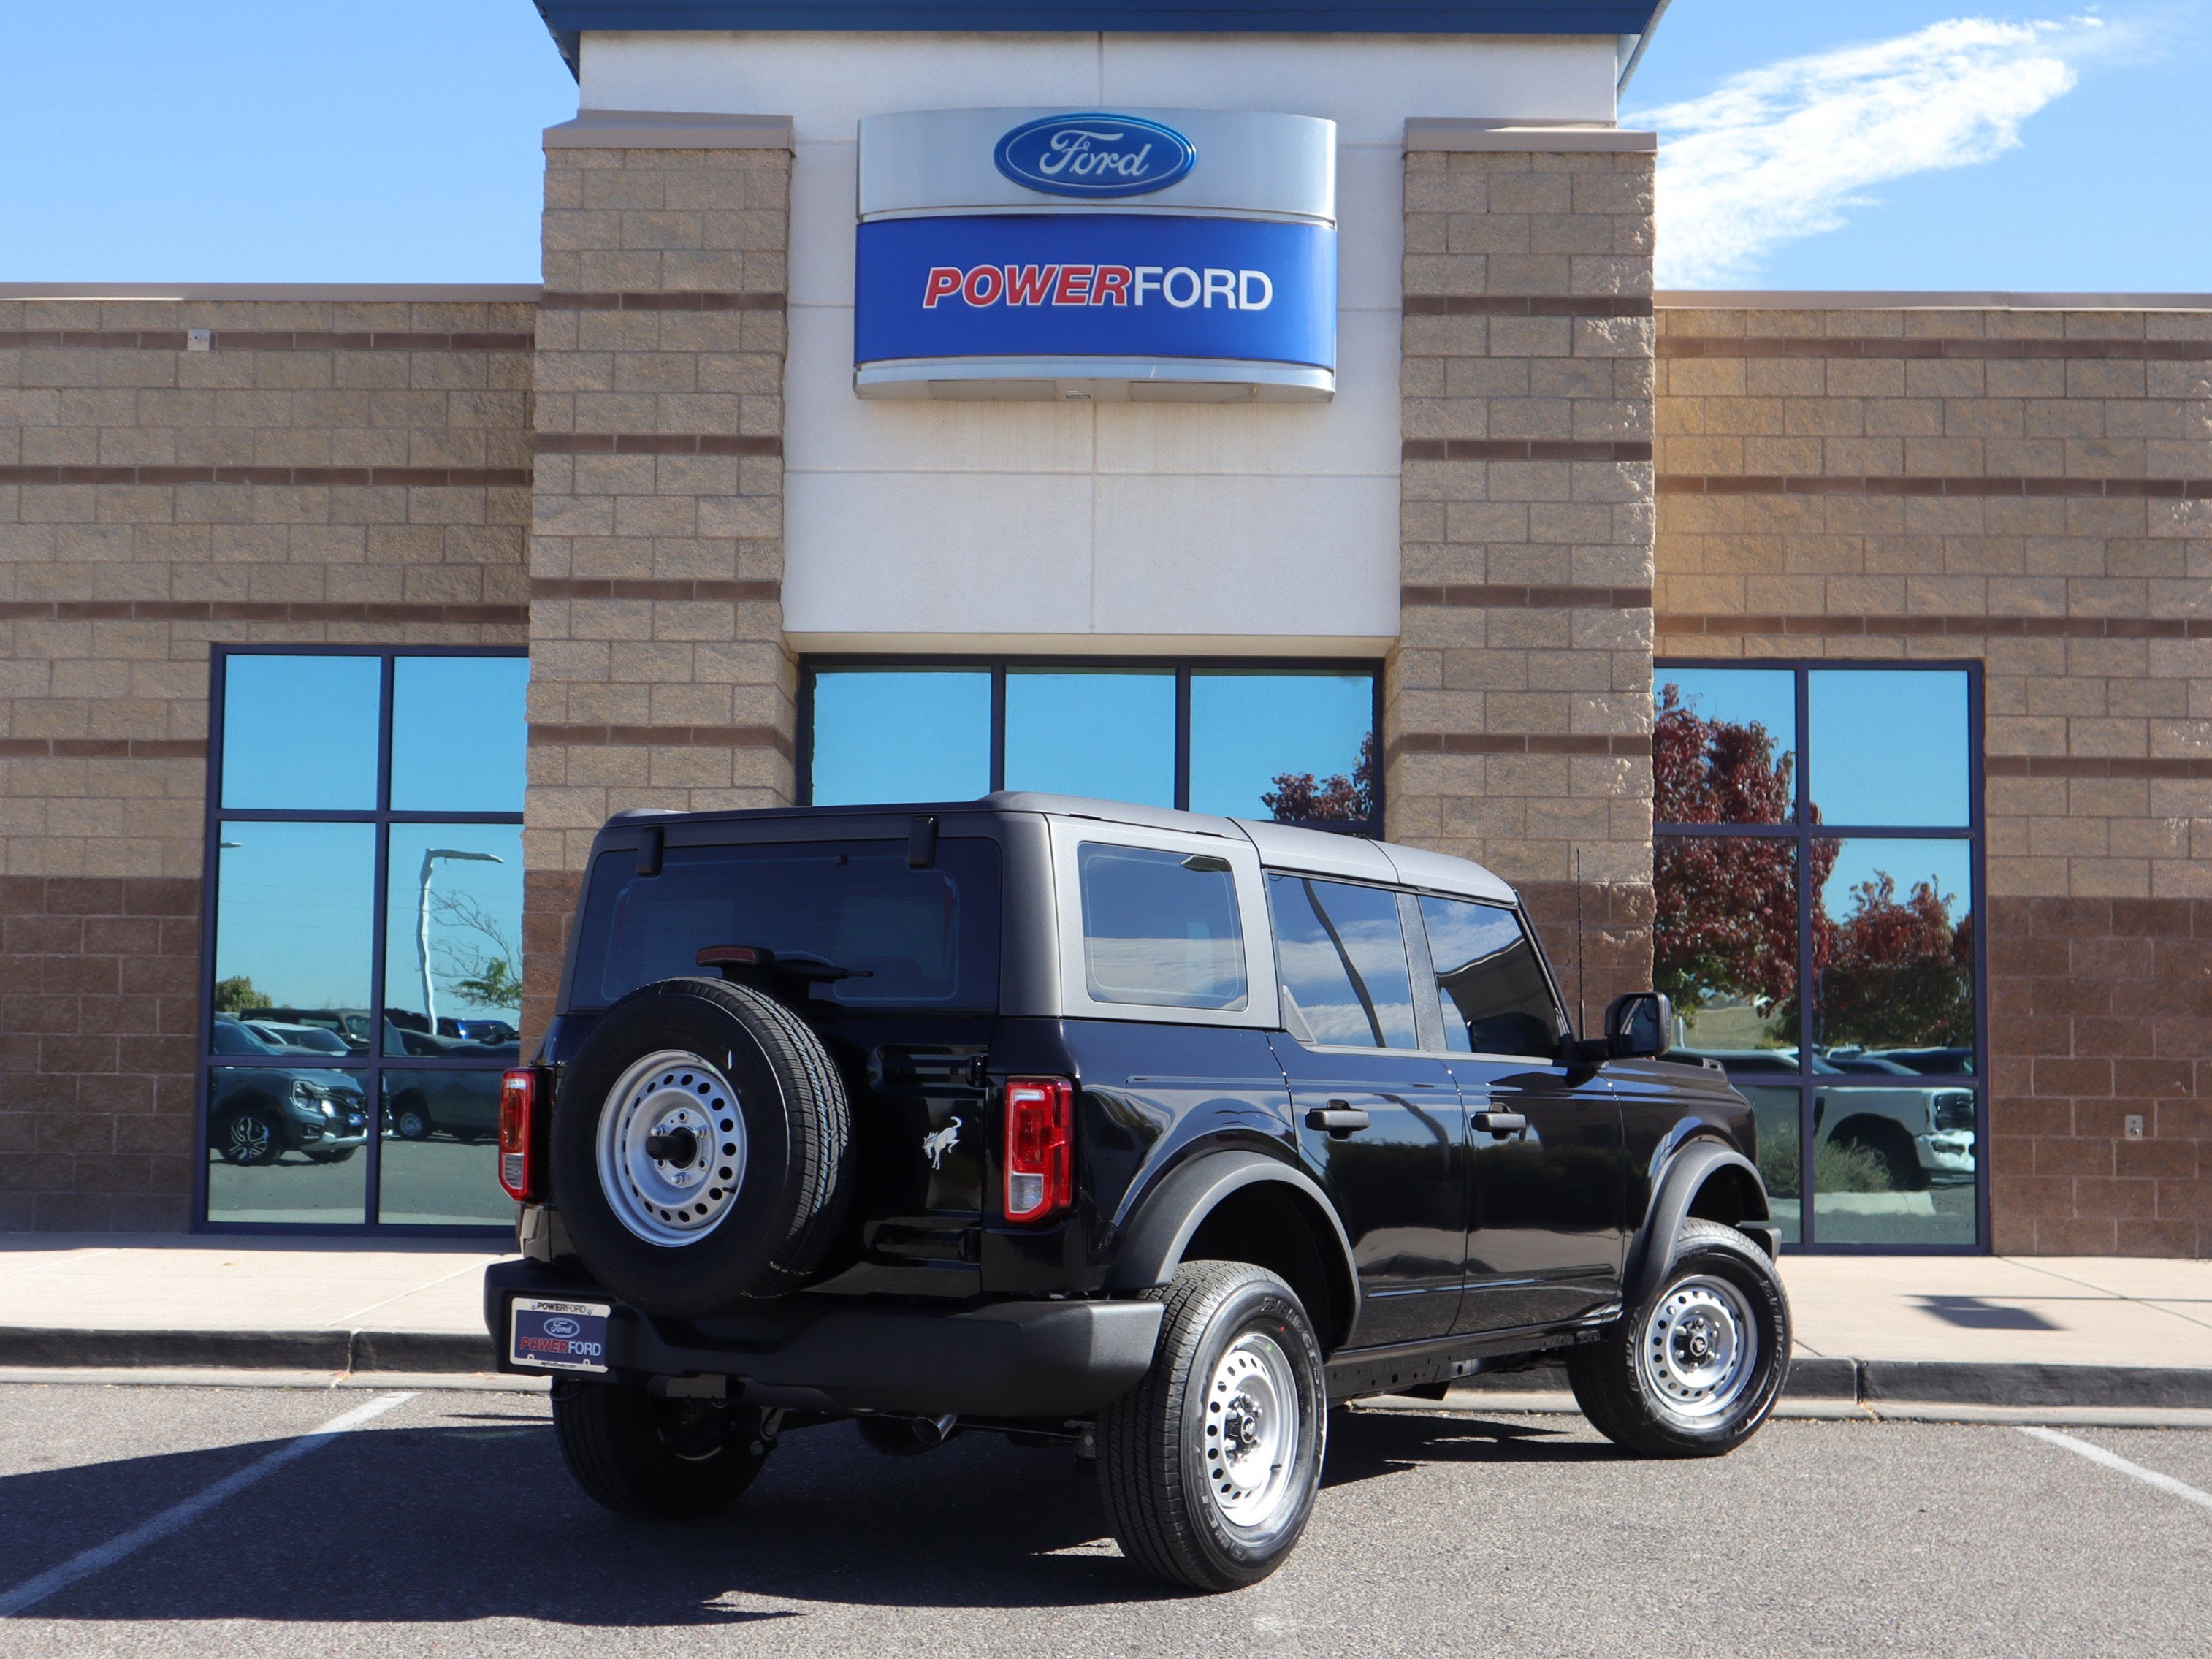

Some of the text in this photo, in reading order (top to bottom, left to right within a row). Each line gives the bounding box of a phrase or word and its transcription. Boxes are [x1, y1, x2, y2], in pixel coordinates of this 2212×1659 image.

[1039, 130, 1151, 176] Ford
[922, 264, 1274, 310] POWERFORD
[538, 1302, 587, 1313] POWERFORD
[550, 1321, 573, 1334] Ford
[520, 1336, 602, 1357] POWERFORD
